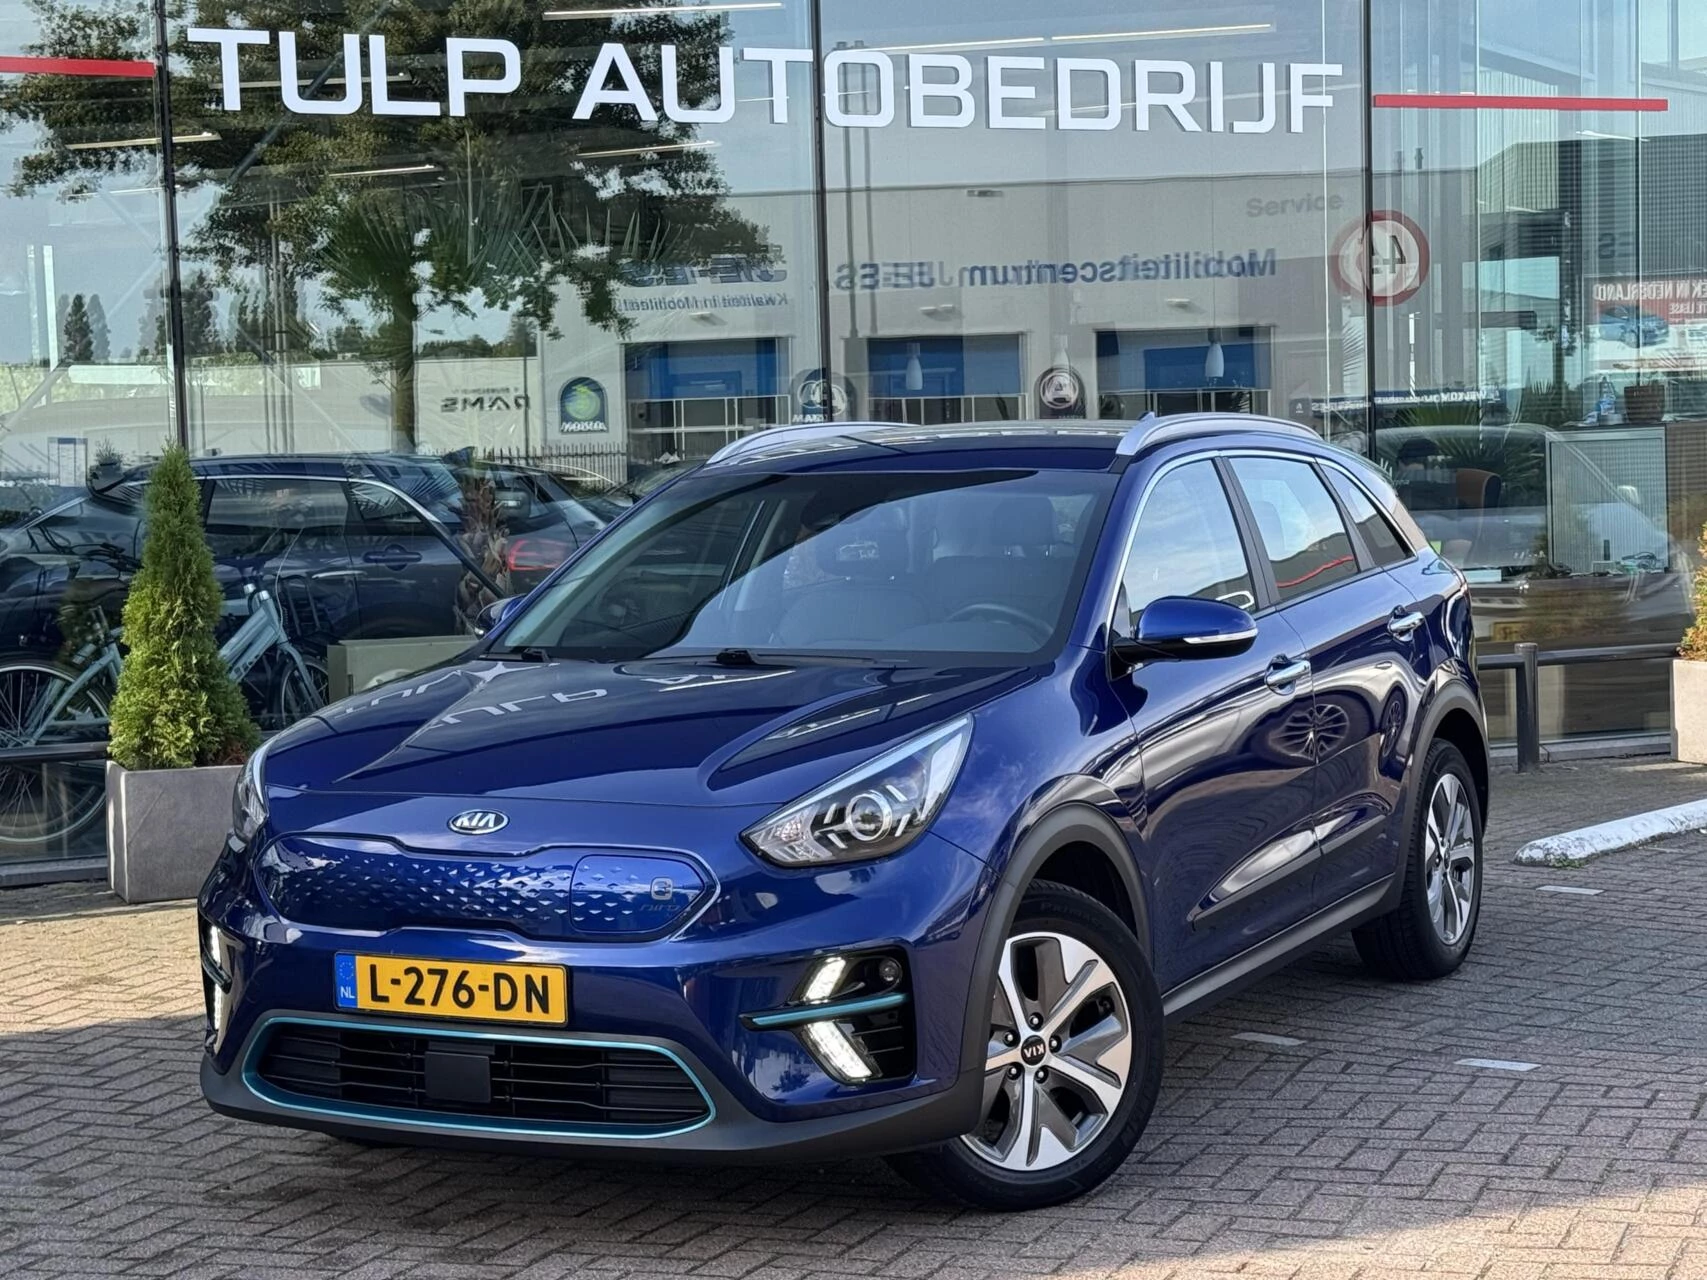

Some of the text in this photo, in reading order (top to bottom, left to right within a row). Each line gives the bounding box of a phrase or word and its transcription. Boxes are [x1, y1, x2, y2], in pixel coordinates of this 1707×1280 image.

[187, 28, 1343, 134] TULP AUTOBEDRIJF
[1246, 192, 1342, 218] Service
[455, 812, 497, 829] KIA
[340, 963, 550, 1014] NL L-276-DN
[1023, 1043, 1045, 1058] KIA
